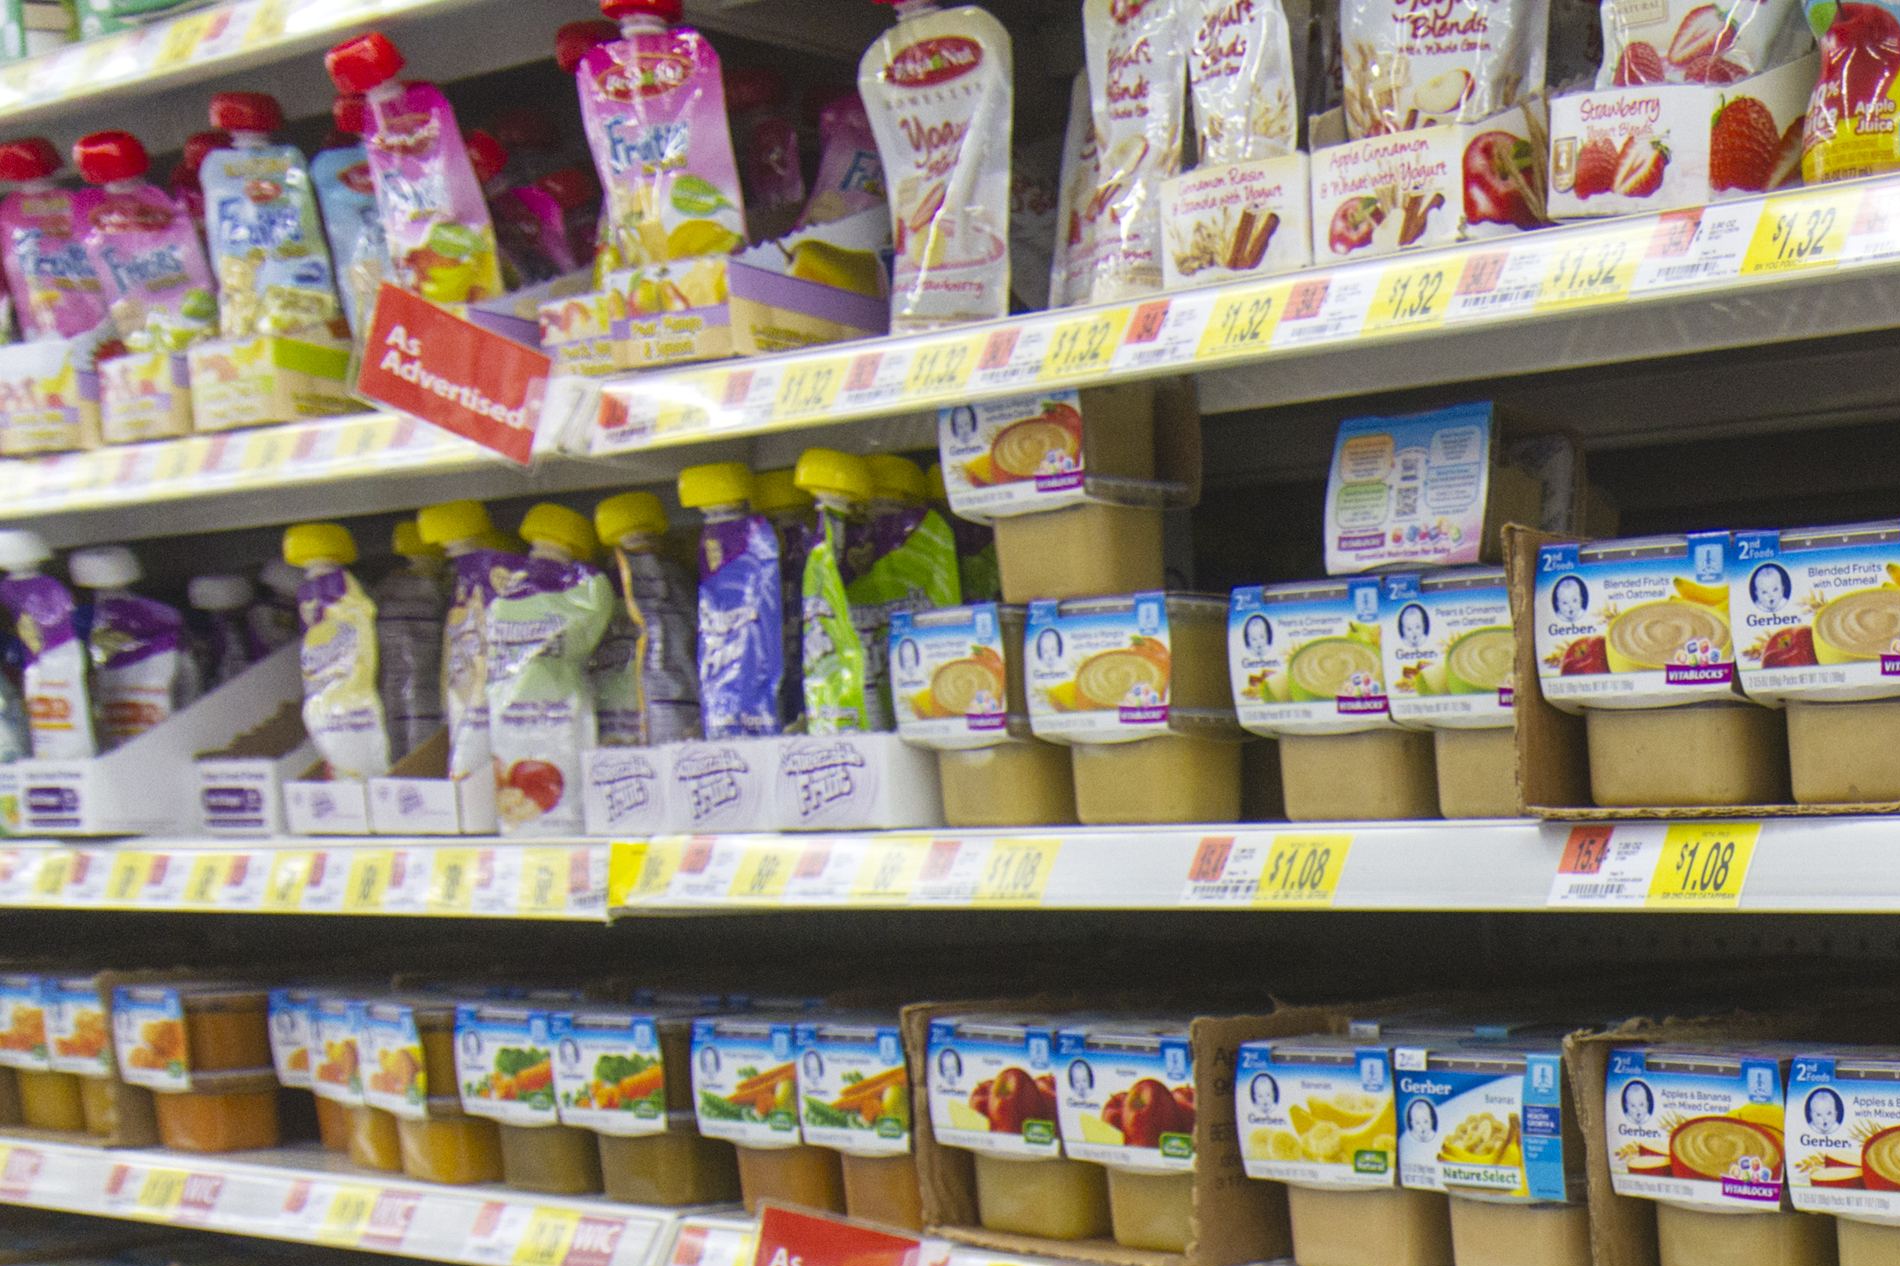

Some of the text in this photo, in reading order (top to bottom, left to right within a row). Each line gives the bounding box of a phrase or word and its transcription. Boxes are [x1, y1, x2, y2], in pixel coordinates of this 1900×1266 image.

[1409, 14, 1490, 39] Blends
[1580, 96, 1660, 124] Strawberry
[1854, 100, 1896, 118] Apple
[1855, 115, 1896, 135] Juice
[1329, 136, 1430, 174] Apple Cinnamon
[1772, 206, 1840, 262] $1.32
[1388, 270, 1444, 321] $1.32
[385, 325, 421, 356] As
[380, 348, 529, 430] Advertised
[1808, 562, 1882, 578] Blended Fruits
[1668, 669, 1725, 683] VITABLOCKS
[1270, 848, 1332, 891] $1.08
[1675, 842, 1735, 892] $1.08
[1400, 1078, 1452, 1095] Gerber
[1660, 1089, 1731, 1102] Apples Bananas
